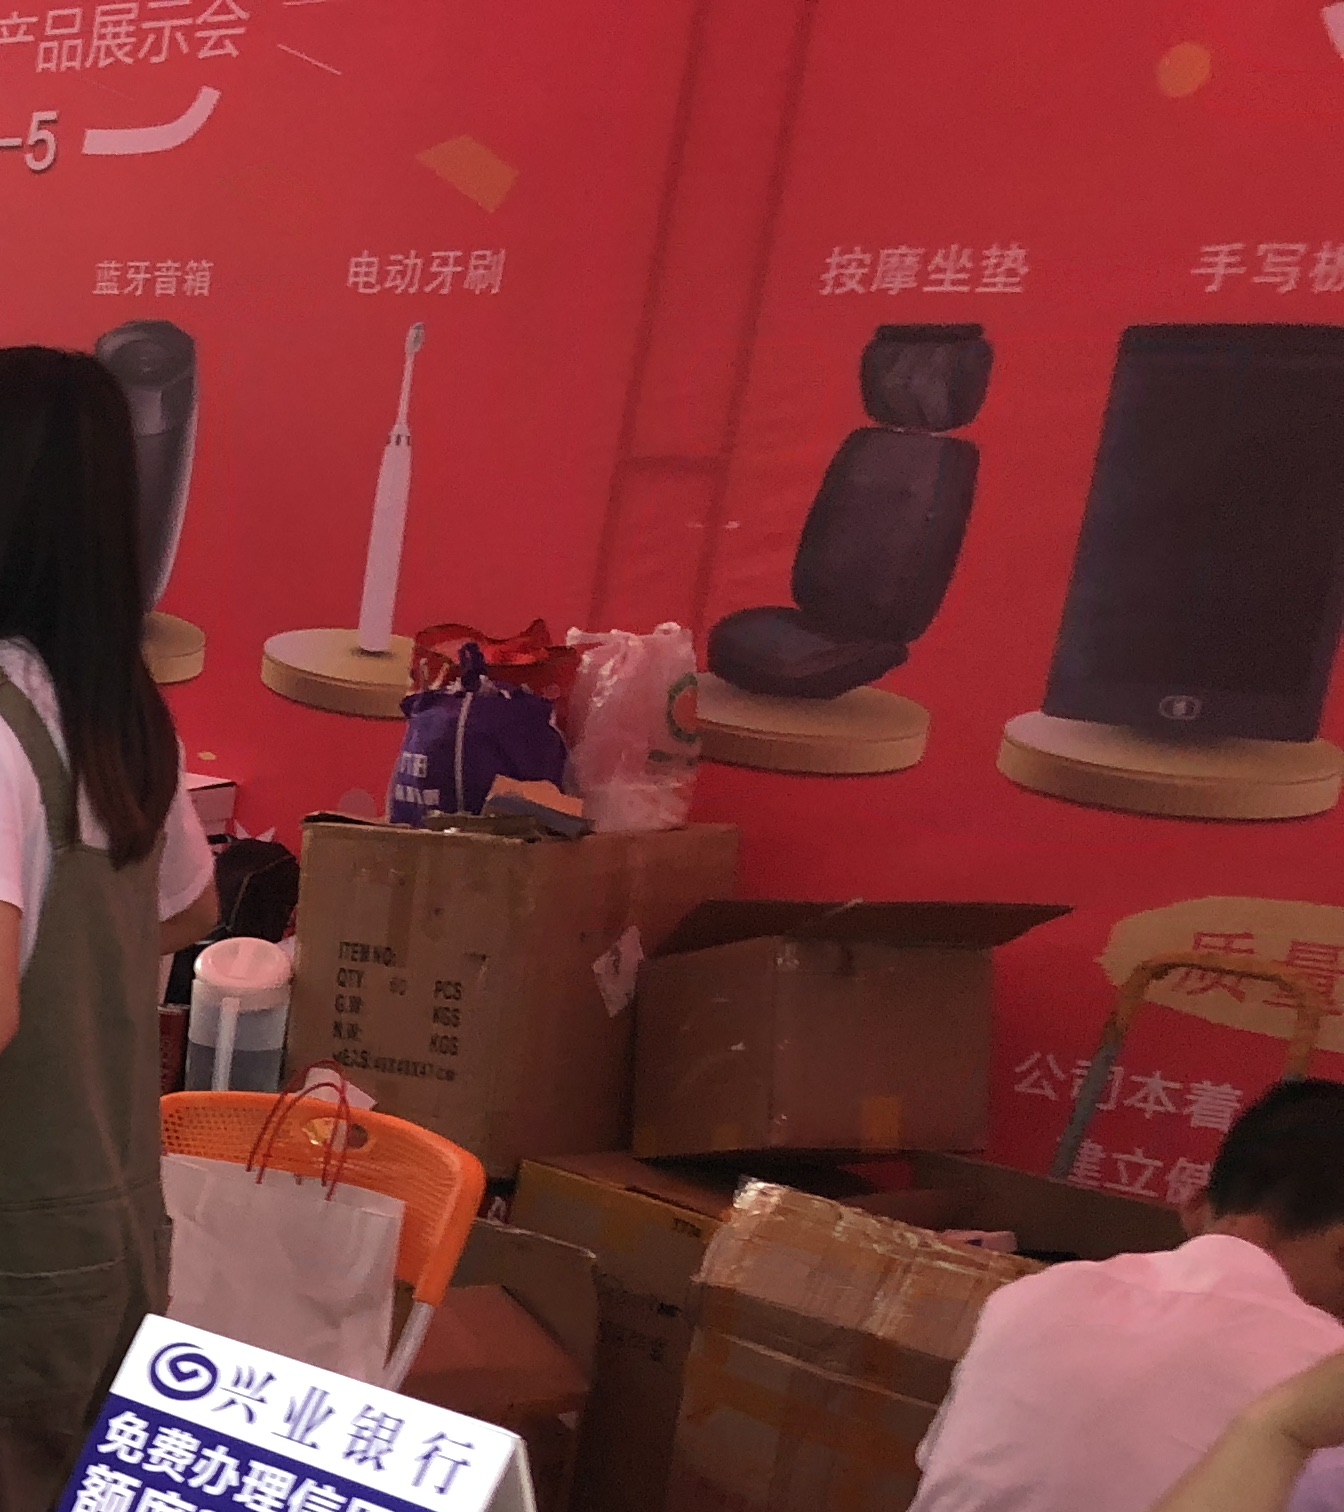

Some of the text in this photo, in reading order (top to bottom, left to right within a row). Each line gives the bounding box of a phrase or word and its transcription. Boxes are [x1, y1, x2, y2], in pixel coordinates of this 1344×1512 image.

[92, 259, 214, 299] 蓝牙音箱
[345, 248, 506, 297] 电动牙刷
[818, 242, 1030, 296] 按摩坐垫
[211, 1364, 475, 1497] 兴业银行
